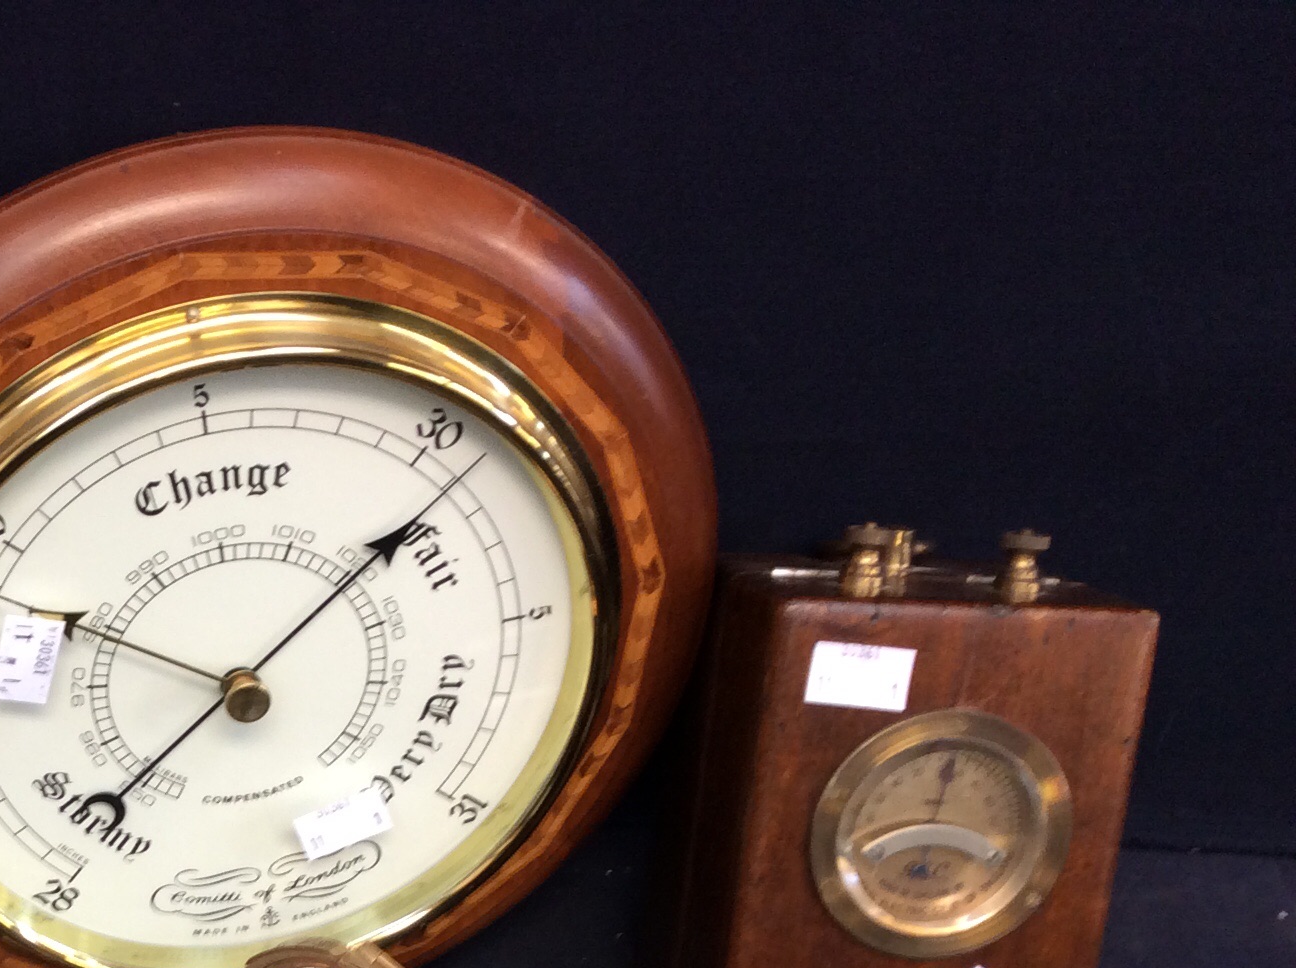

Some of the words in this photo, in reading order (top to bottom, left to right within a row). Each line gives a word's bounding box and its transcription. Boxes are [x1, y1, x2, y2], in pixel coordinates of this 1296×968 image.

[193, 383, 210, 408] 5
[416, 408, 464, 450] 30
[134, 460, 292, 518] Change
[191, 524, 246, 548] 1000
[271, 524, 316, 545] 1010
[125, 550, 170, 585] 990
[403, 521, 460, 592] Fair
[382, 595, 406, 641] 1030
[529, 605, 552, 621] 5
[33, 639, 55, 675] 30361
[69, 667, 86, 708] 970
[384, 658, 407, 707] 1040
[79, 729, 107, 767] 960
[347, 723, 384, 764] 1050
[359, 729, 443, 804] Very
[418, 654, 475, 727] Dry
[202, 774, 304, 806] COMPENSATED
[449, 793, 489, 826] 31
[31, 771, 152, 863] Stormy
[31, 878, 81, 912] 28
[254, 883, 276, 904] of
[283, 853, 367, 893] London
[192, 925, 228, 937] MADE
[235, 924, 250, 935] IN
[291, 896, 349, 922] ENGLAND
